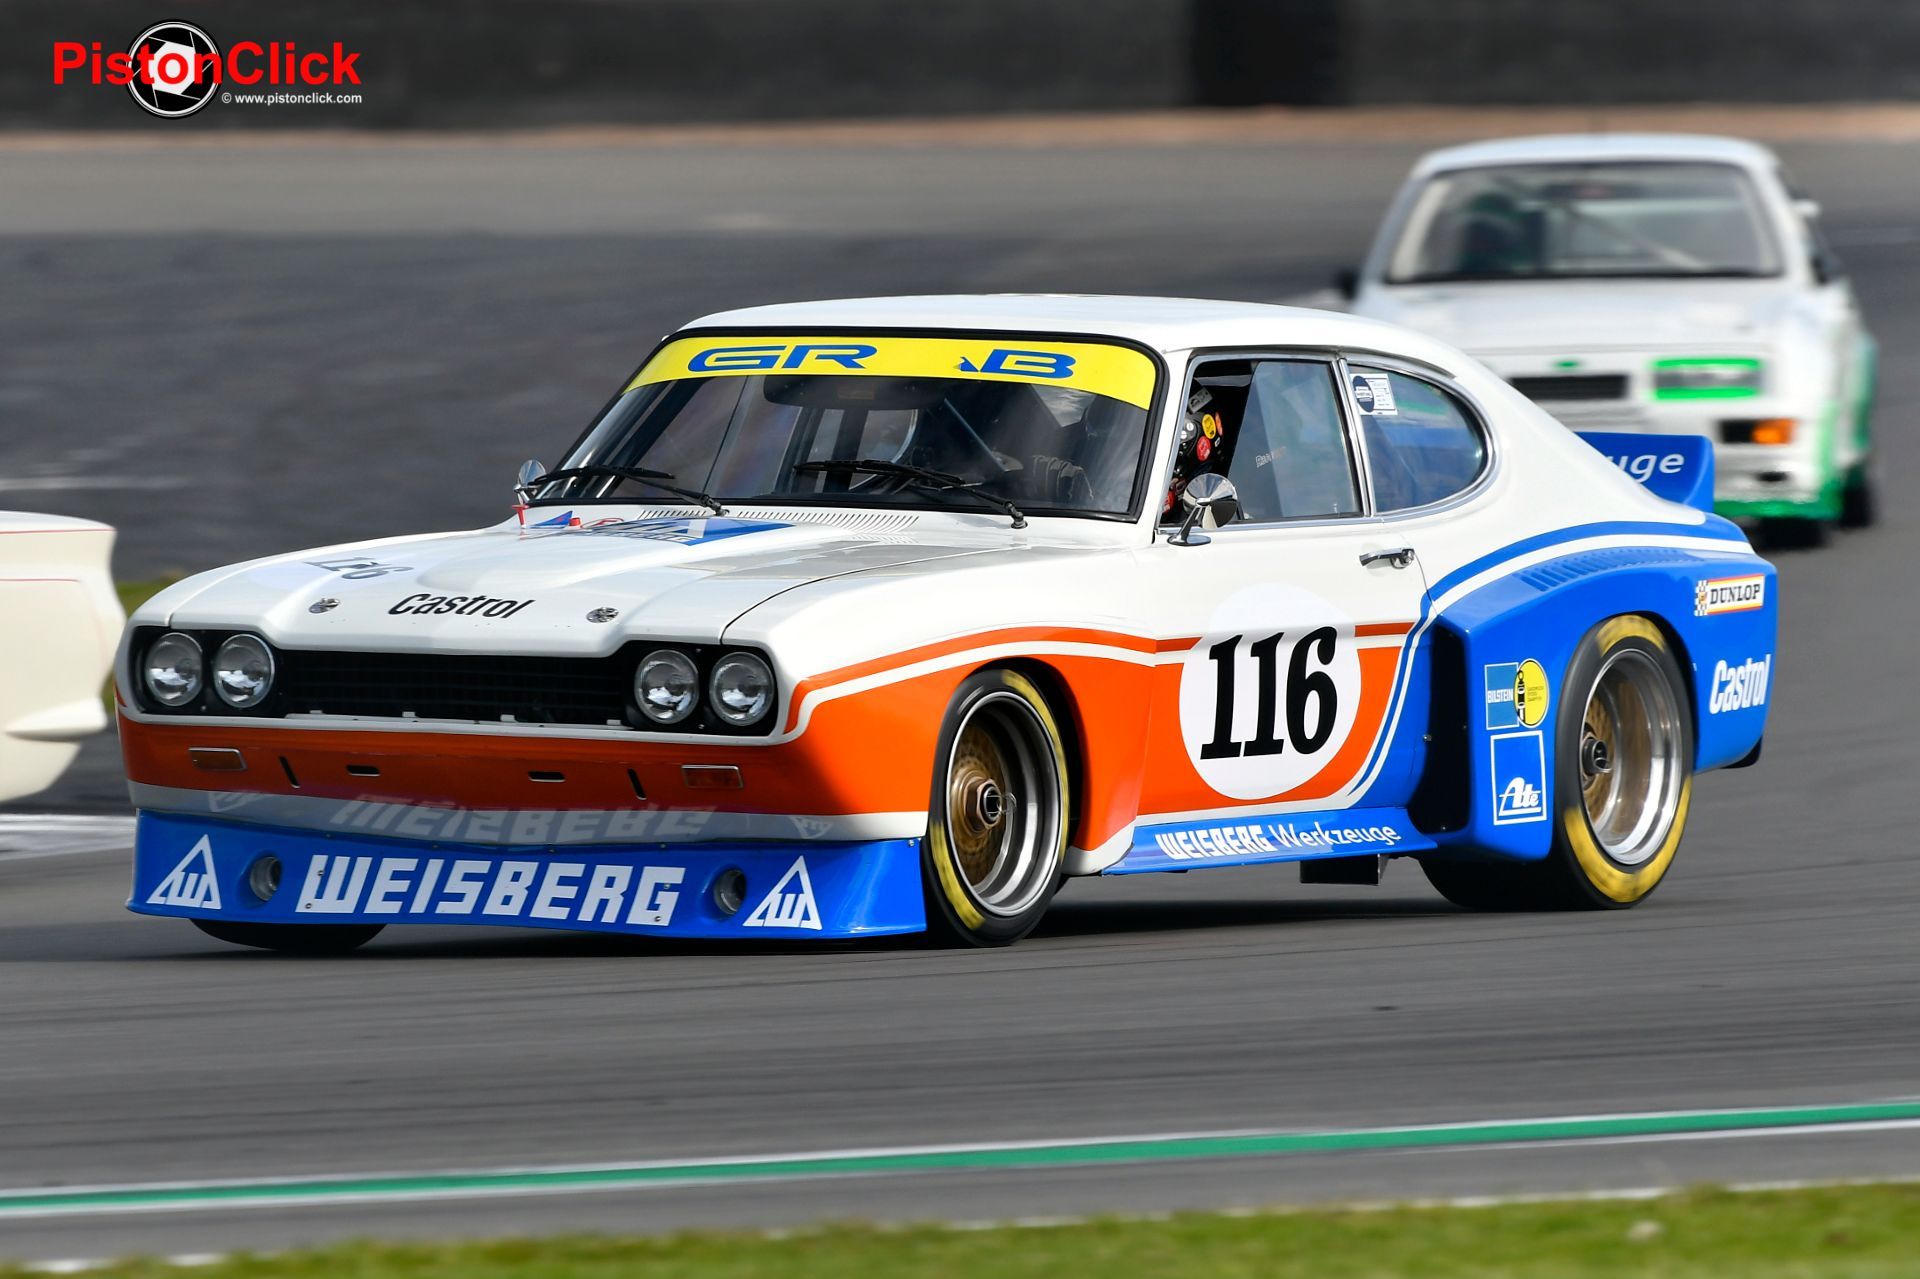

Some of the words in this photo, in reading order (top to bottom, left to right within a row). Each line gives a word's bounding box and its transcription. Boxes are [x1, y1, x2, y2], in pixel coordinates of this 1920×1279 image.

[687, 344, 877, 372] GR
[388, 593, 536, 618] Castrol
[1709, 583, 1761, 605] DUNLOP
[1200, 626, 1338, 760] 116
[1709, 653, 1771, 715] Castrol
[1498, 776, 1541, 816] Ate
[1155, 825, 1278, 860] WEISBERG
[1268, 822, 1401, 847] Werkzeuge
[295, 855, 686, 926] WEISBERG
